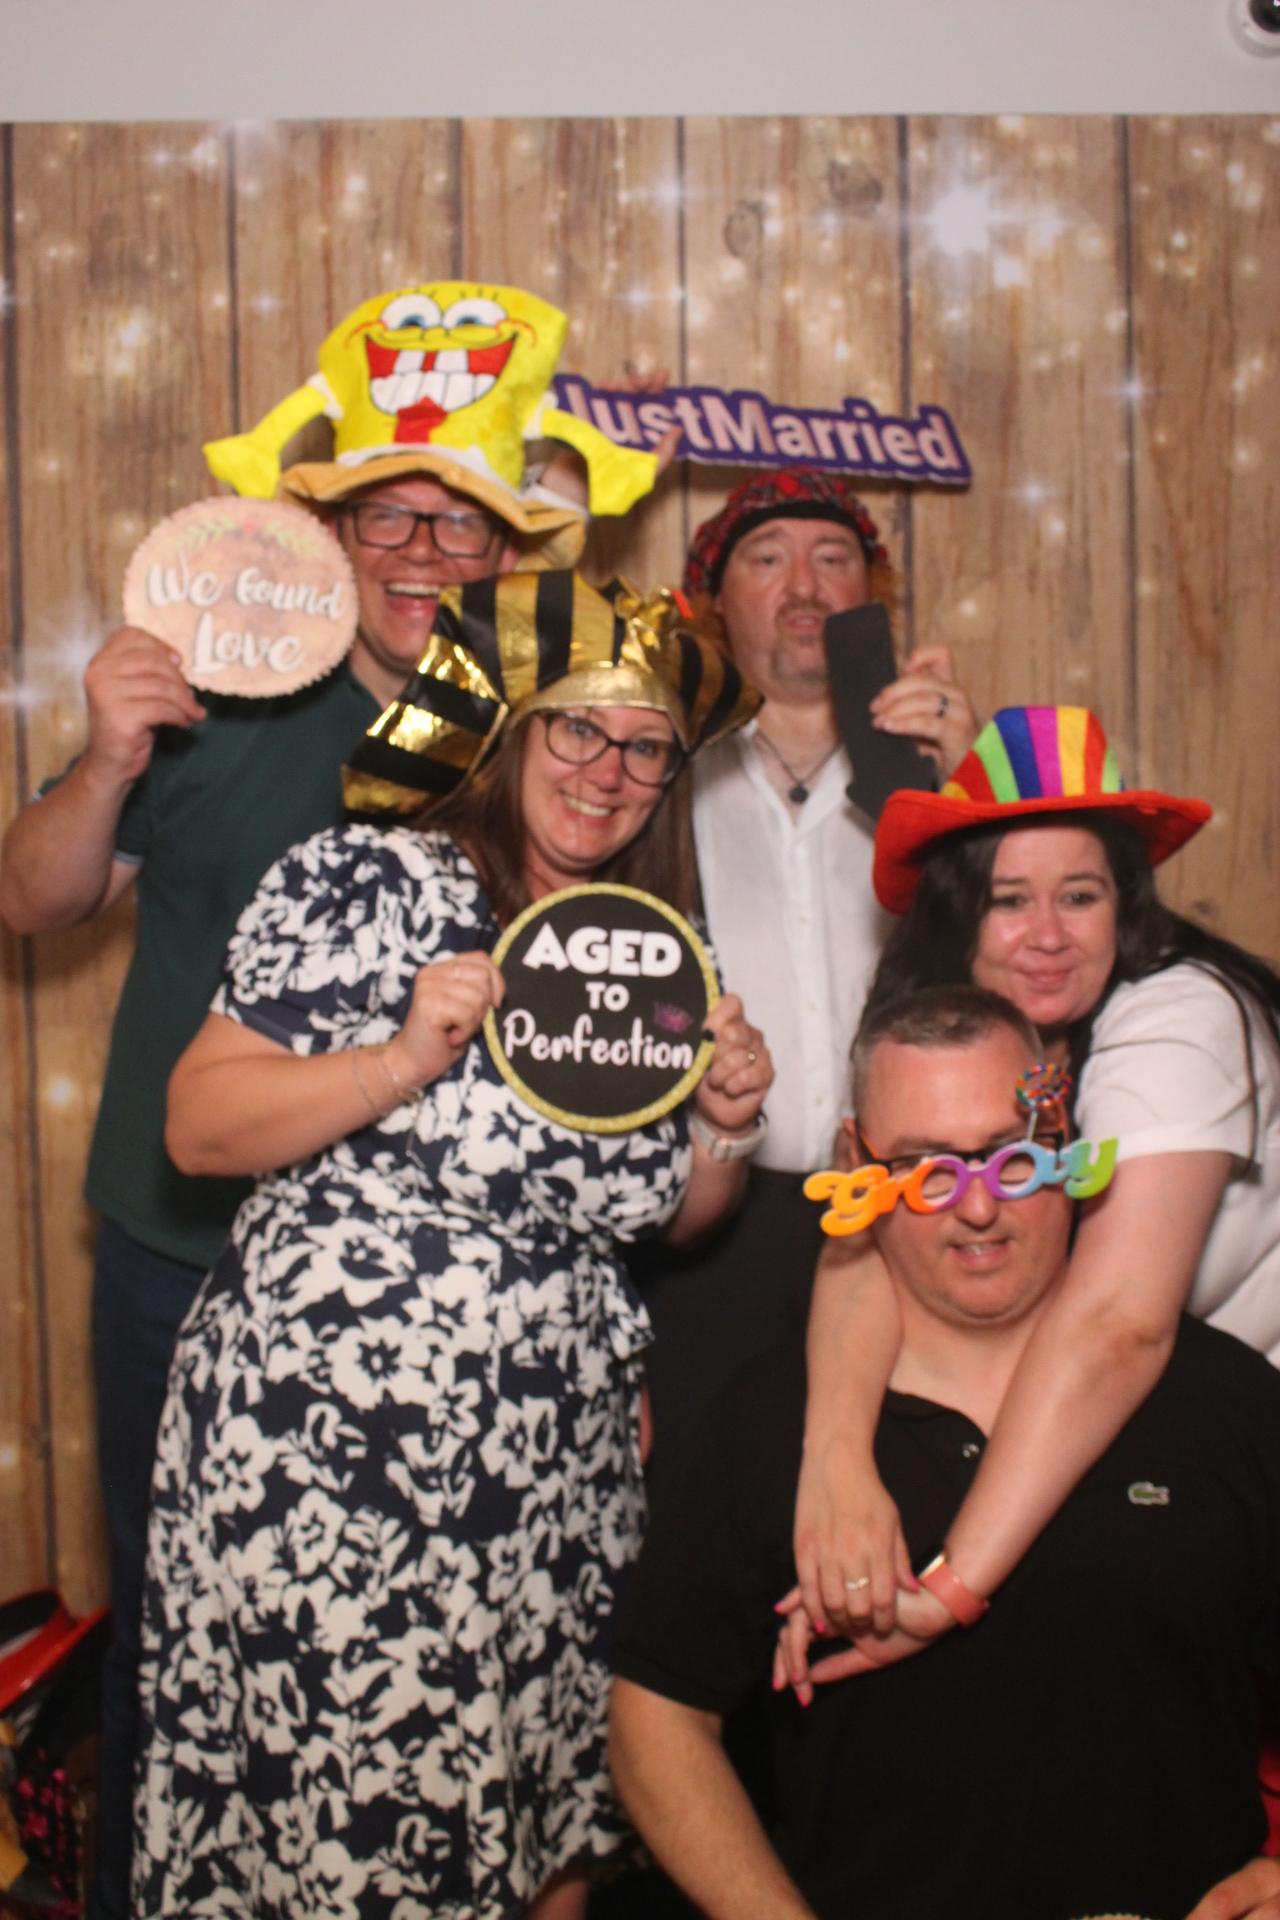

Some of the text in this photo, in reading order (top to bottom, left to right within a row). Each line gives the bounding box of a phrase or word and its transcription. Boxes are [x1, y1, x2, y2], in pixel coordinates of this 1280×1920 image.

[146, 553, 343, 621] We found
[191, 611, 305, 673] Love
[522, 922, 682, 977] AGED
[585, 982, 630, 1012] TO
[503, 1009, 693, 1069] Perfection
